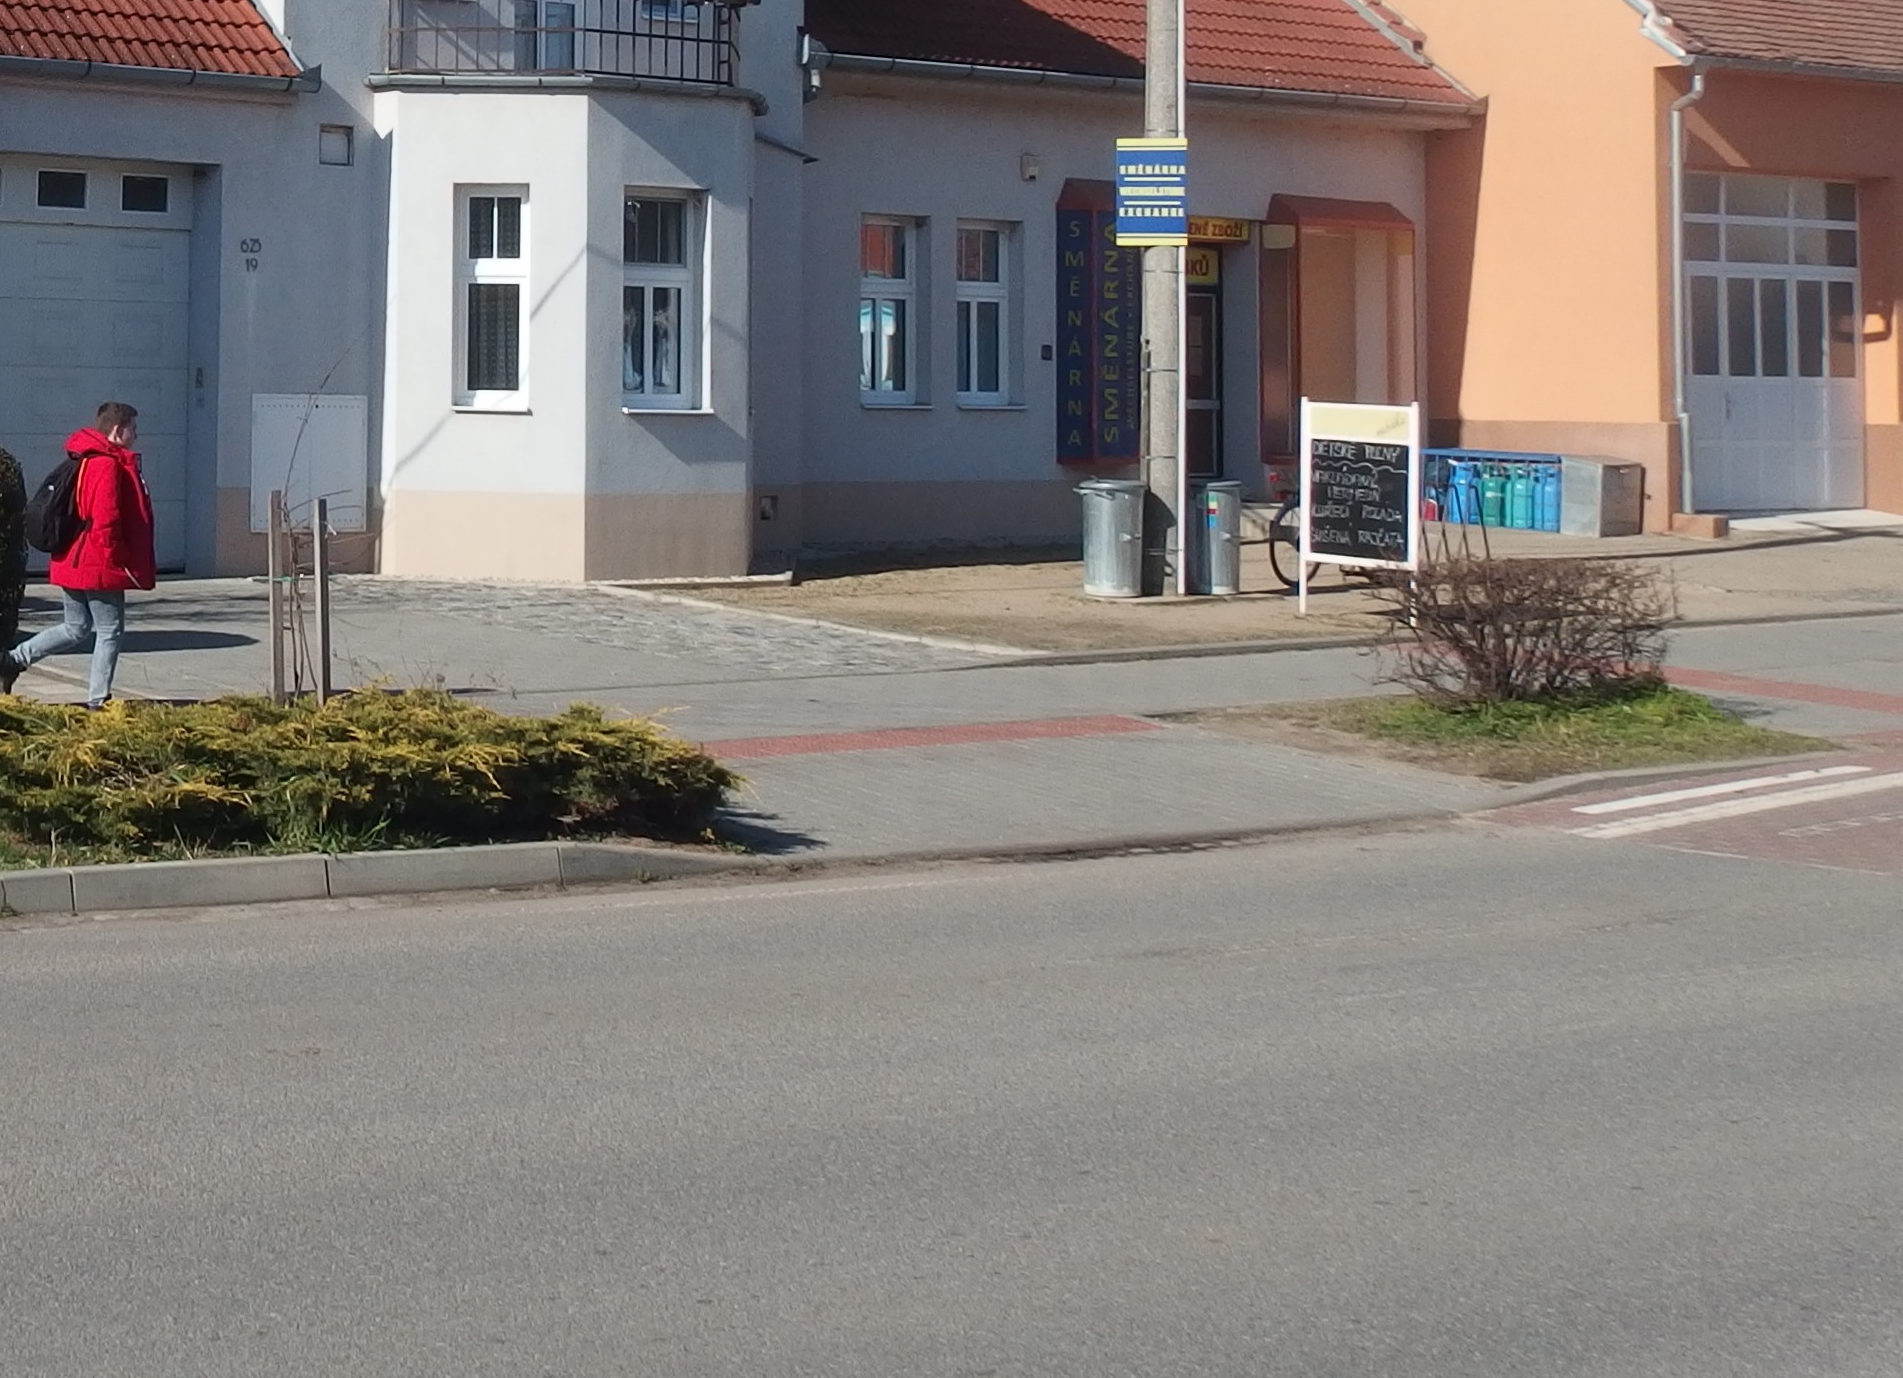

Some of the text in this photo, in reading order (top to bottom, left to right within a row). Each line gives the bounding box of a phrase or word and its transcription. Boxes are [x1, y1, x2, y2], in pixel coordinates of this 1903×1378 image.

[1189, 221, 1243, 238] ENÉ ZBOŽÍ
[245, 258, 258, 272] 19
[1187, 254, 1210, 275] KŮ
[1064, 221, 1085, 446] SMĚNÁRNA
